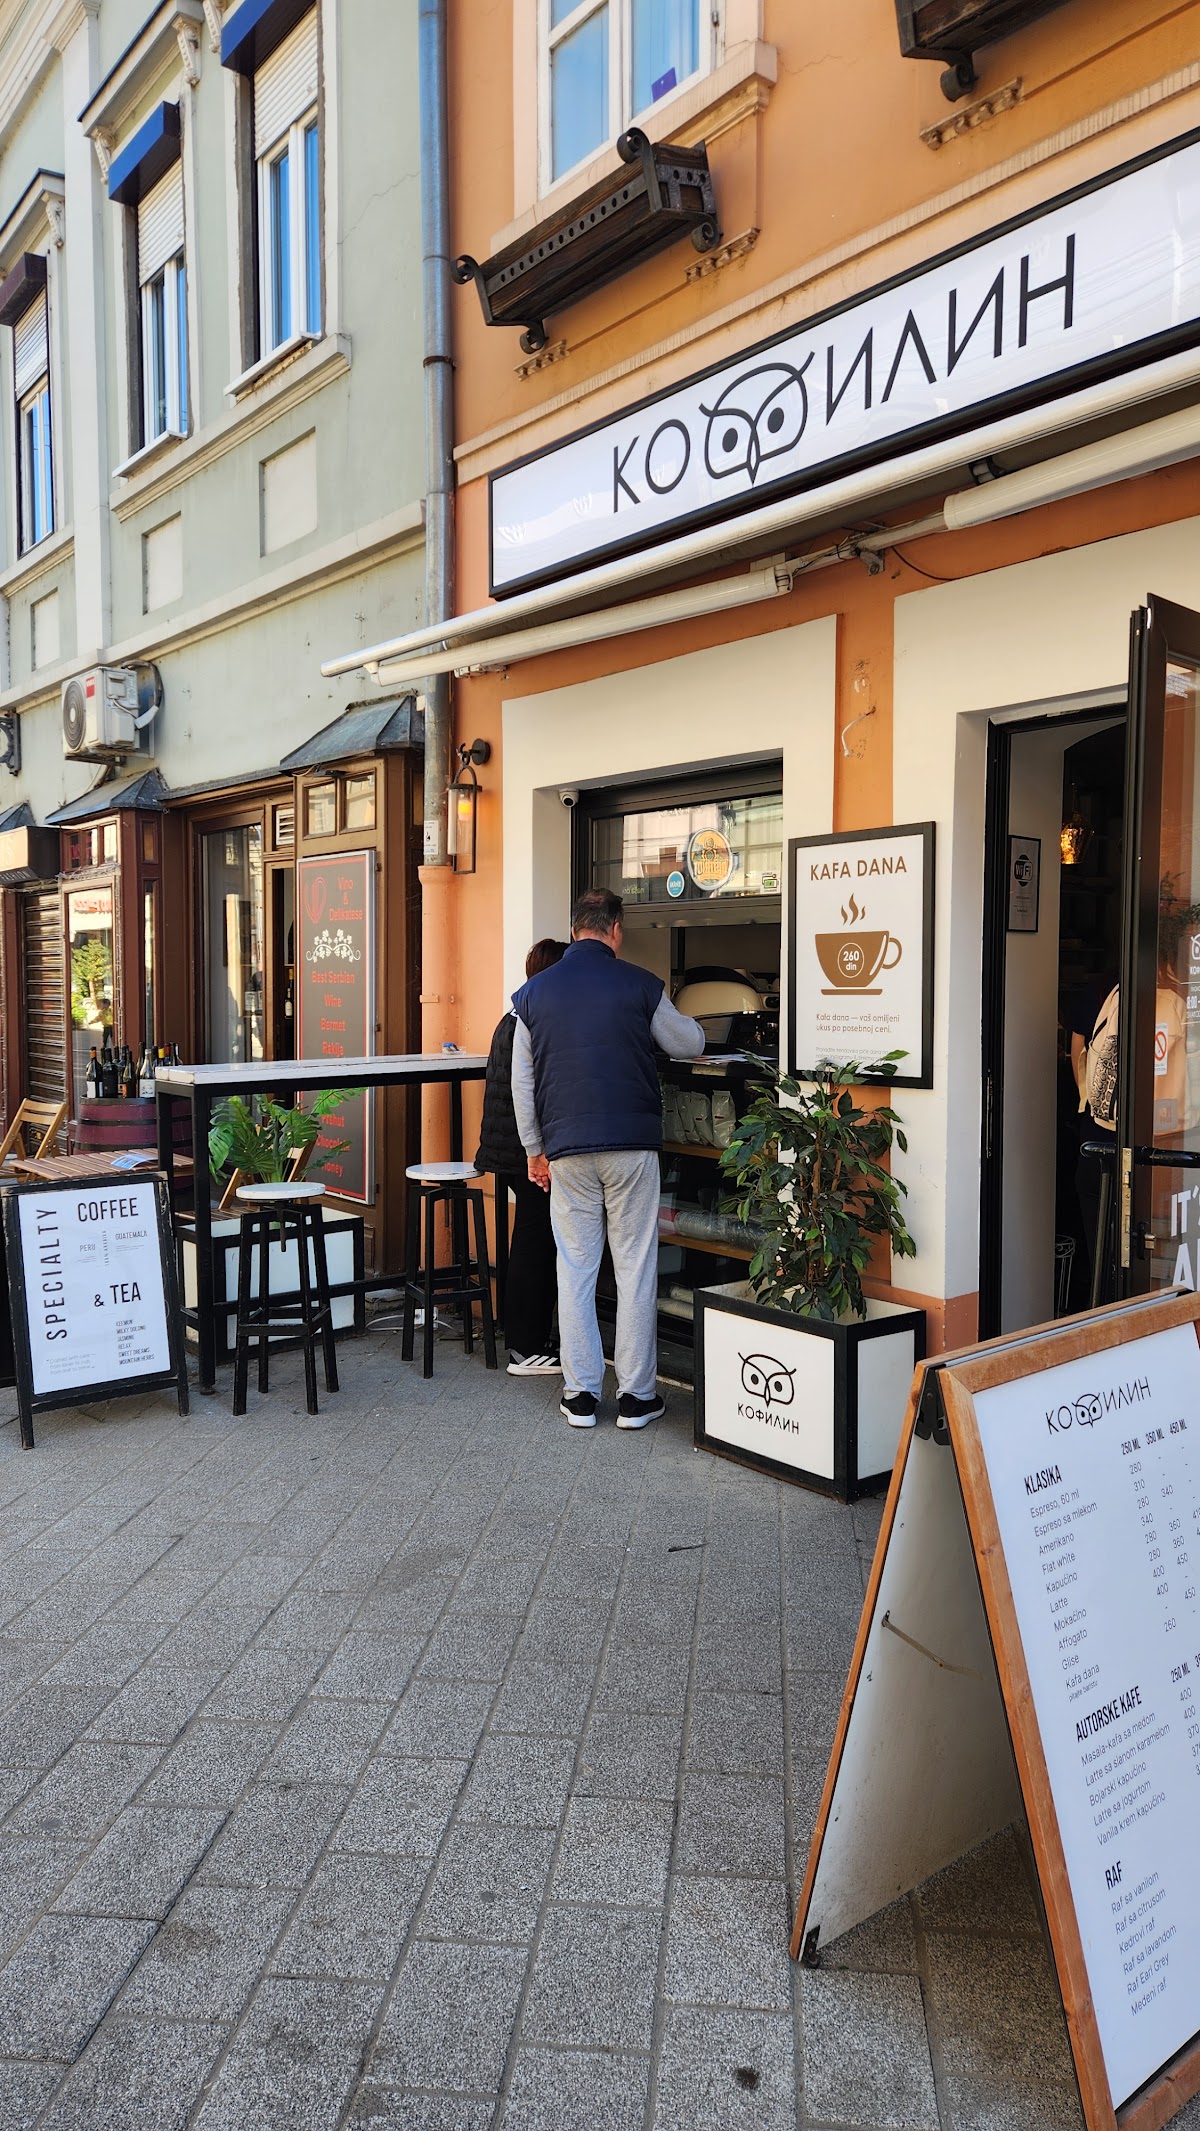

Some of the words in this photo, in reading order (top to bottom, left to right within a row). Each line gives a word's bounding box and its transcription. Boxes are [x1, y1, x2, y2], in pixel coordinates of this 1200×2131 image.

[810, 862, 851, 881] KAFA
[857, 856, 907, 877] DANA
[338, 877, 353, 890] Vino
[329, 908, 363, 920] Delikatese
[843, 951, 860, 962] 260
[845, 963, 857, 971] din
[311, 971, 328, 983] Best
[328, 971, 355, 984] Serbian
[324, 995, 342, 1007] Wine
[321, 1018, 346, 1031] Bermet
[816, 1013, 831, 1021] Kafa
[859, 1014, 871, 1022] vaš
[873, 1014, 900, 1024] omiljeni
[832, 1025, 841, 1033] po
[842, 1025, 874, 1034] posebnoj
[322, 1041, 344, 1057] Rakija
[77, 1197, 139, 1222] COFFEE
[115, 1230, 147, 1240] GUATEMALA
[80, 1244, 96, 1252] PERU
[36, 1209, 67, 1341] SPECIALTY
[94, 1294, 105, 1307] &
[110, 1282, 141, 1304] TEA
[738, 1402, 799, 1435] КОФИЛИН
[1121, 1443, 1133, 1455] 250
[1132, 1437, 1141, 1450] ML
[1145, 1432, 1157, 1445] 350
[1156, 1428, 1165, 1440] ML
[1169, 1422, 1179, 1435] 450
[1179, 1418, 1187, 1430] ML
[1024, 1465, 1062, 1495] KLASIKA
[1134, 1479, 1146, 1492] 310
[1030, 1499, 1061, 1519] Espreso,
[1060, 1492, 1070, 1505] 60
[1071, 1488, 1080, 1501] ml
[1137, 1496, 1150, 1509] 280
[1161, 1484, 1174, 1498] 340
[1034, 1518, 1062, 1538] Espreso
[1063, 1514, 1072, 1524] sa
[1072, 1502, 1098, 1521] mlekom
[1141, 1513, 1154, 1527] 340
[1039, 1532, 1075, 1557] Amerikano
[1145, 1530, 1157, 1544] 280
[1042, 1560, 1056, 1575] Flat
[1056, 1552, 1076, 1568] white
[1153, 1565, 1165, 1578] 400
[1177, 1552, 1188, 1565] 450
[1157, 1582, 1168, 1595] 400
[1185, 1586, 1196, 1600] 450
[1050, 1597, 1068, 1613] Latte
[1164, 1617, 1176, 1632] 260
[1058, 1629, 1088, 1652] Affogato
[1065, 1673, 1082, 1690] Kafa
[1083, 1664, 1100, 1681] dana
[1171, 1666, 1182, 1683] 250
[1182, 1662, 1191, 1677] ML
[1180, 1687, 1191, 1702] 400
[1076, 1699, 1120, 1743] AUTORSKE
[1119, 1685, 1142, 1715] KAFE
[1184, 1705, 1196, 1720] 400
[1081, 1734, 1123, 1767] Masala-kafa
[1123, 1727, 1132, 1740] sa
[1132, 1712, 1156, 1735] medom
[1188, 1723, 1200, 1739] 370
[1085, 1768, 1104, 1787] Latte
[1104, 1761, 1113, 1773] sa
[1113, 1745, 1137, 1769] slanom
[1136, 1724, 1171, 1752] karamelom
[1089, 1779, 1117, 1807] Bojarski
[1093, 1808, 1112, 1827] Latte
[1112, 1801, 1122, 1812] sa
[1121, 1779, 1152, 1807] jogurtom
[1097, 1823, 1119, 1846] Vanila
[1119, 1812, 1137, 1832] krem
[1105, 1861, 1122, 1890] RAF
[1111, 1896, 1123, 1914] Raf
[1124, 1892, 1133, 1905] sa
[1133, 1871, 1160, 1897] vanilom
[1115, 1917, 1127, 1935] Raf
[1129, 1911, 1137, 1923] sa
[1137, 1888, 1166, 1917] citrusom
[1119, 1927, 1146, 1955] Kedrovi
[1143, 1917, 1156, 1935] raf
[1123, 1958, 1135, 1975] Raf
[1136, 1952, 1145, 1965] sa
[1144, 1924, 1177, 1957] lavandom
[1127, 1977, 1139, 1995] Raf
[1139, 1965, 1153, 1984] Earl
[1153, 1953, 1169, 1972] Grey
[1131, 1988, 1157, 2016] Medeni
[1157, 1977, 1167, 1994] raf
